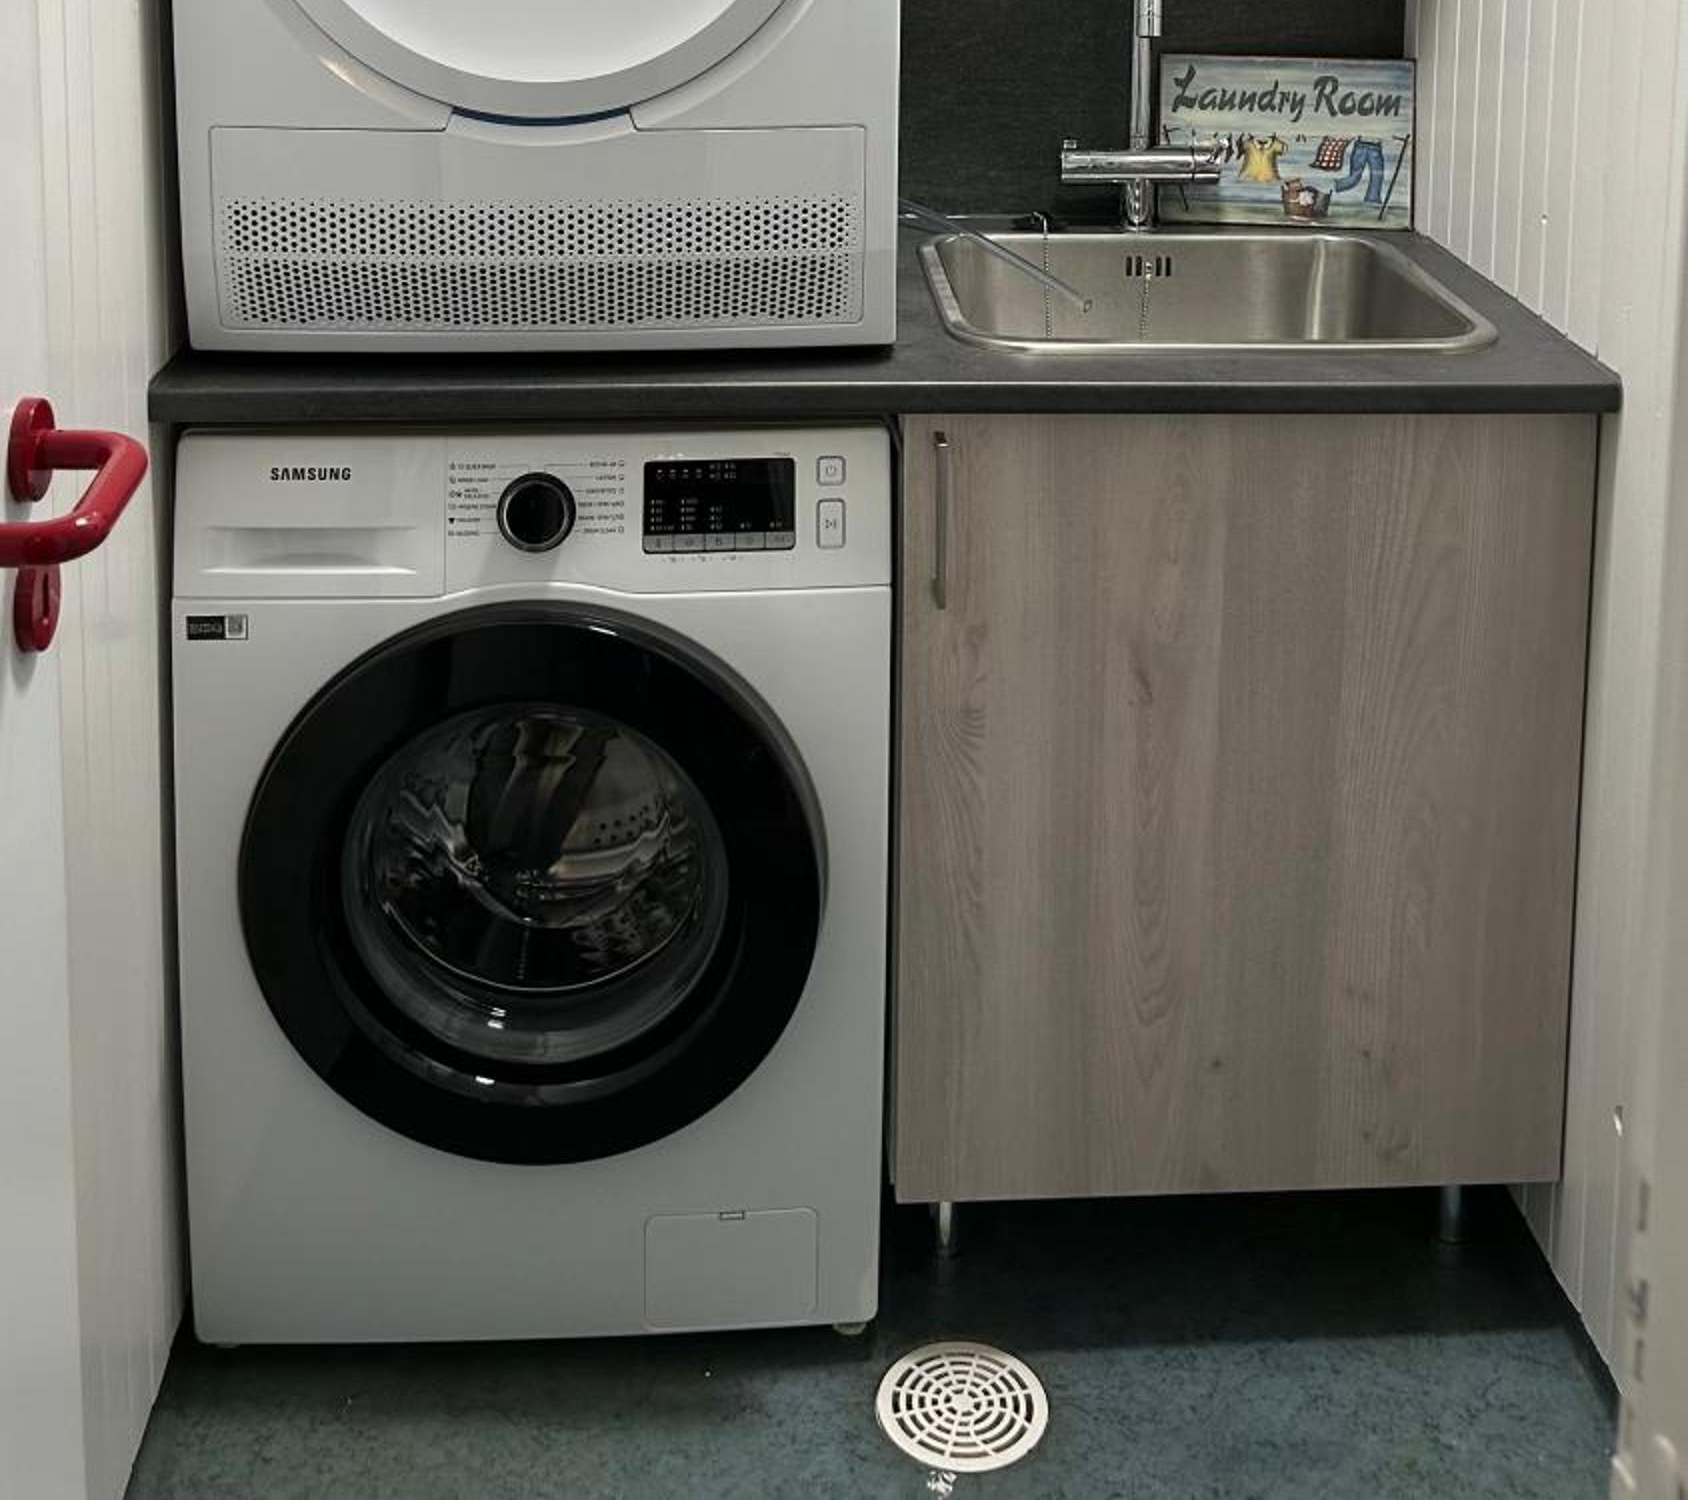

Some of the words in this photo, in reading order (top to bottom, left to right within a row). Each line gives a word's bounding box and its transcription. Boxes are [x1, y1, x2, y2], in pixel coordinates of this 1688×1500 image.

[1171, 63, 1307, 123] Laundry
[1313, 75, 1402, 117] Room
[270, 467, 352, 482] SAMSUNG
